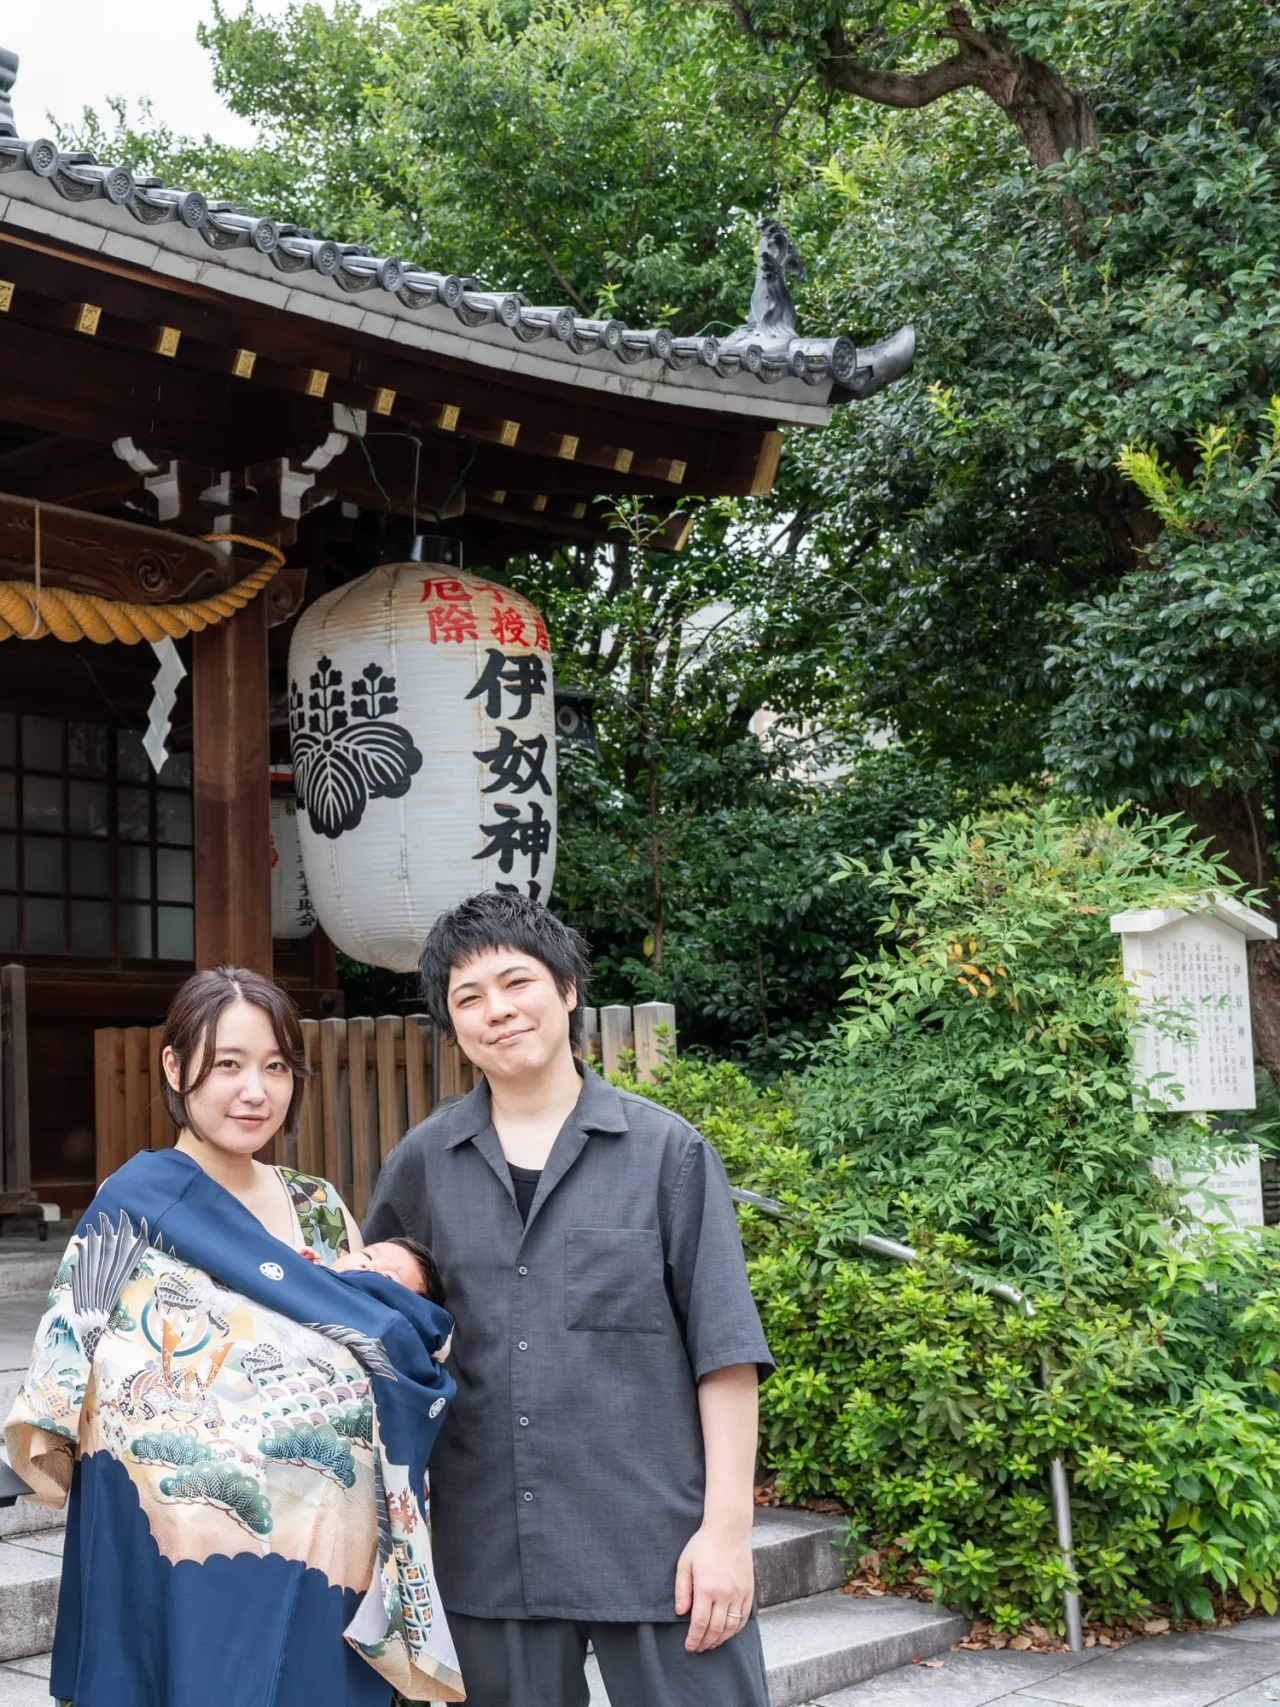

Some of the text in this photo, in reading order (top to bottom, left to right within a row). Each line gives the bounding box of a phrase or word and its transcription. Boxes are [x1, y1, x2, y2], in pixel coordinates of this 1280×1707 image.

[419, 576, 479, 645] 厄除
[463, 648, 552, 902] 伊奴神
